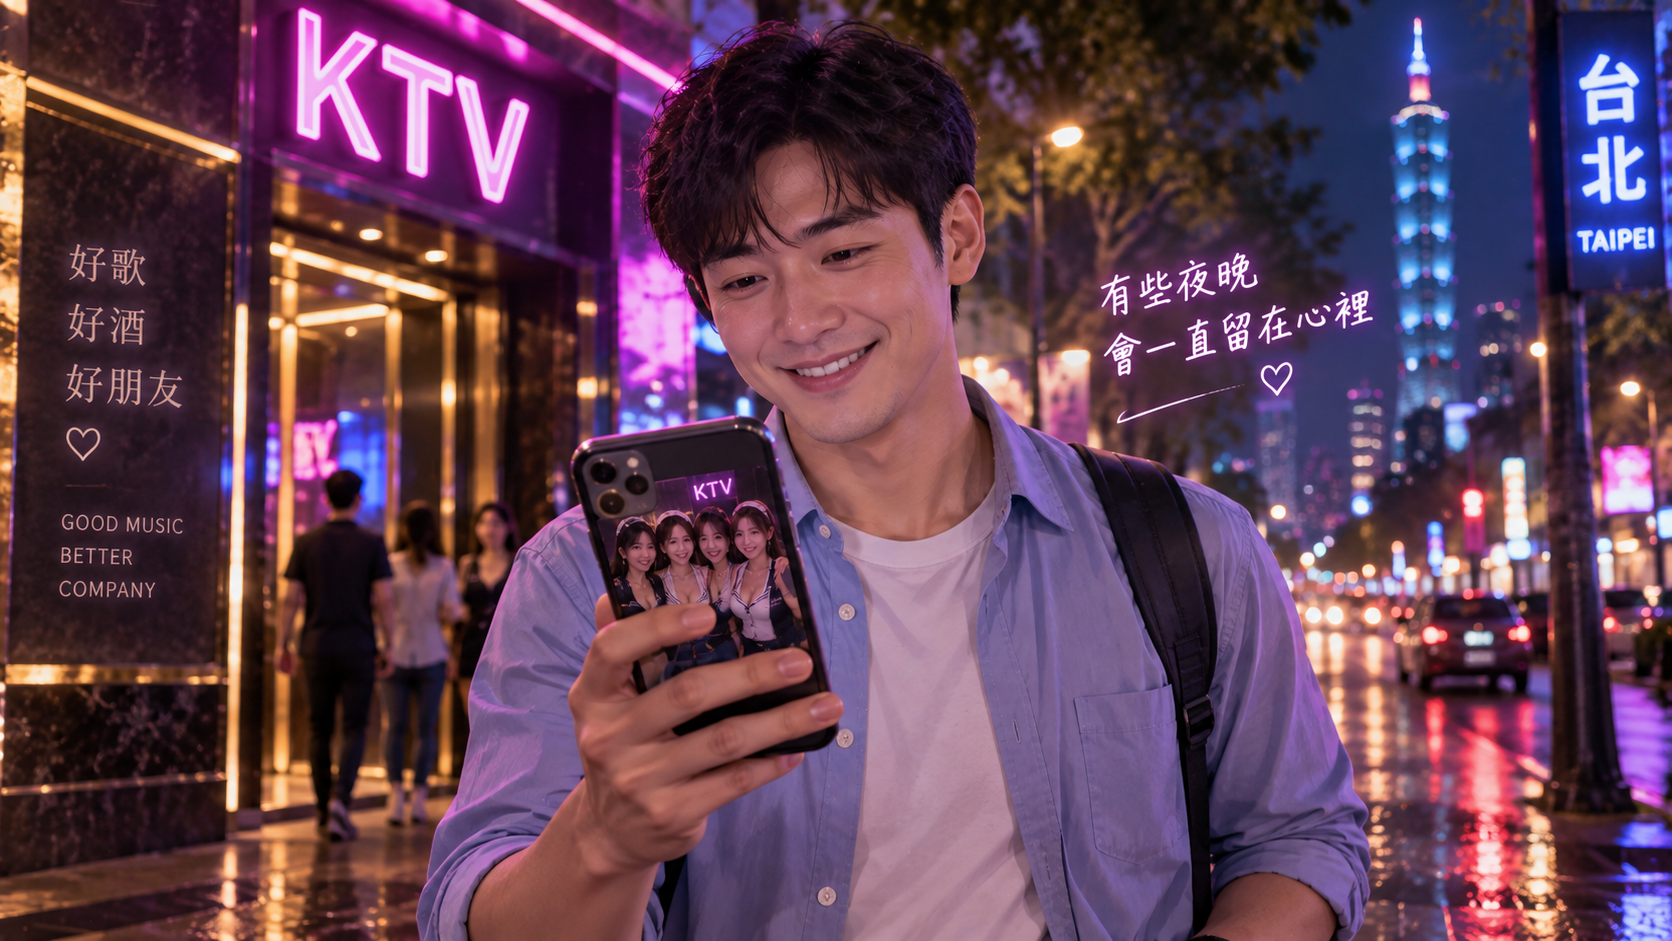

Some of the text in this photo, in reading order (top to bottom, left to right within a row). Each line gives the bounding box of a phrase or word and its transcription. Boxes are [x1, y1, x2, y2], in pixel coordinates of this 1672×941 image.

[296, 7, 531, 204] KTV
[1578, 53, 1647, 205] 台北
[1576, 226, 1656, 254] TAIPEI
[69, 243, 146, 287] 好歌
[67, 303, 146, 346] 好酒
[65, 363, 183, 409] 好朋友
[693, 478, 733, 501] KTV
[61, 513, 184, 535] GOOD MUSIC
[60, 546, 133, 566] BETTER
[59, 580, 157, 599] COMPANY
